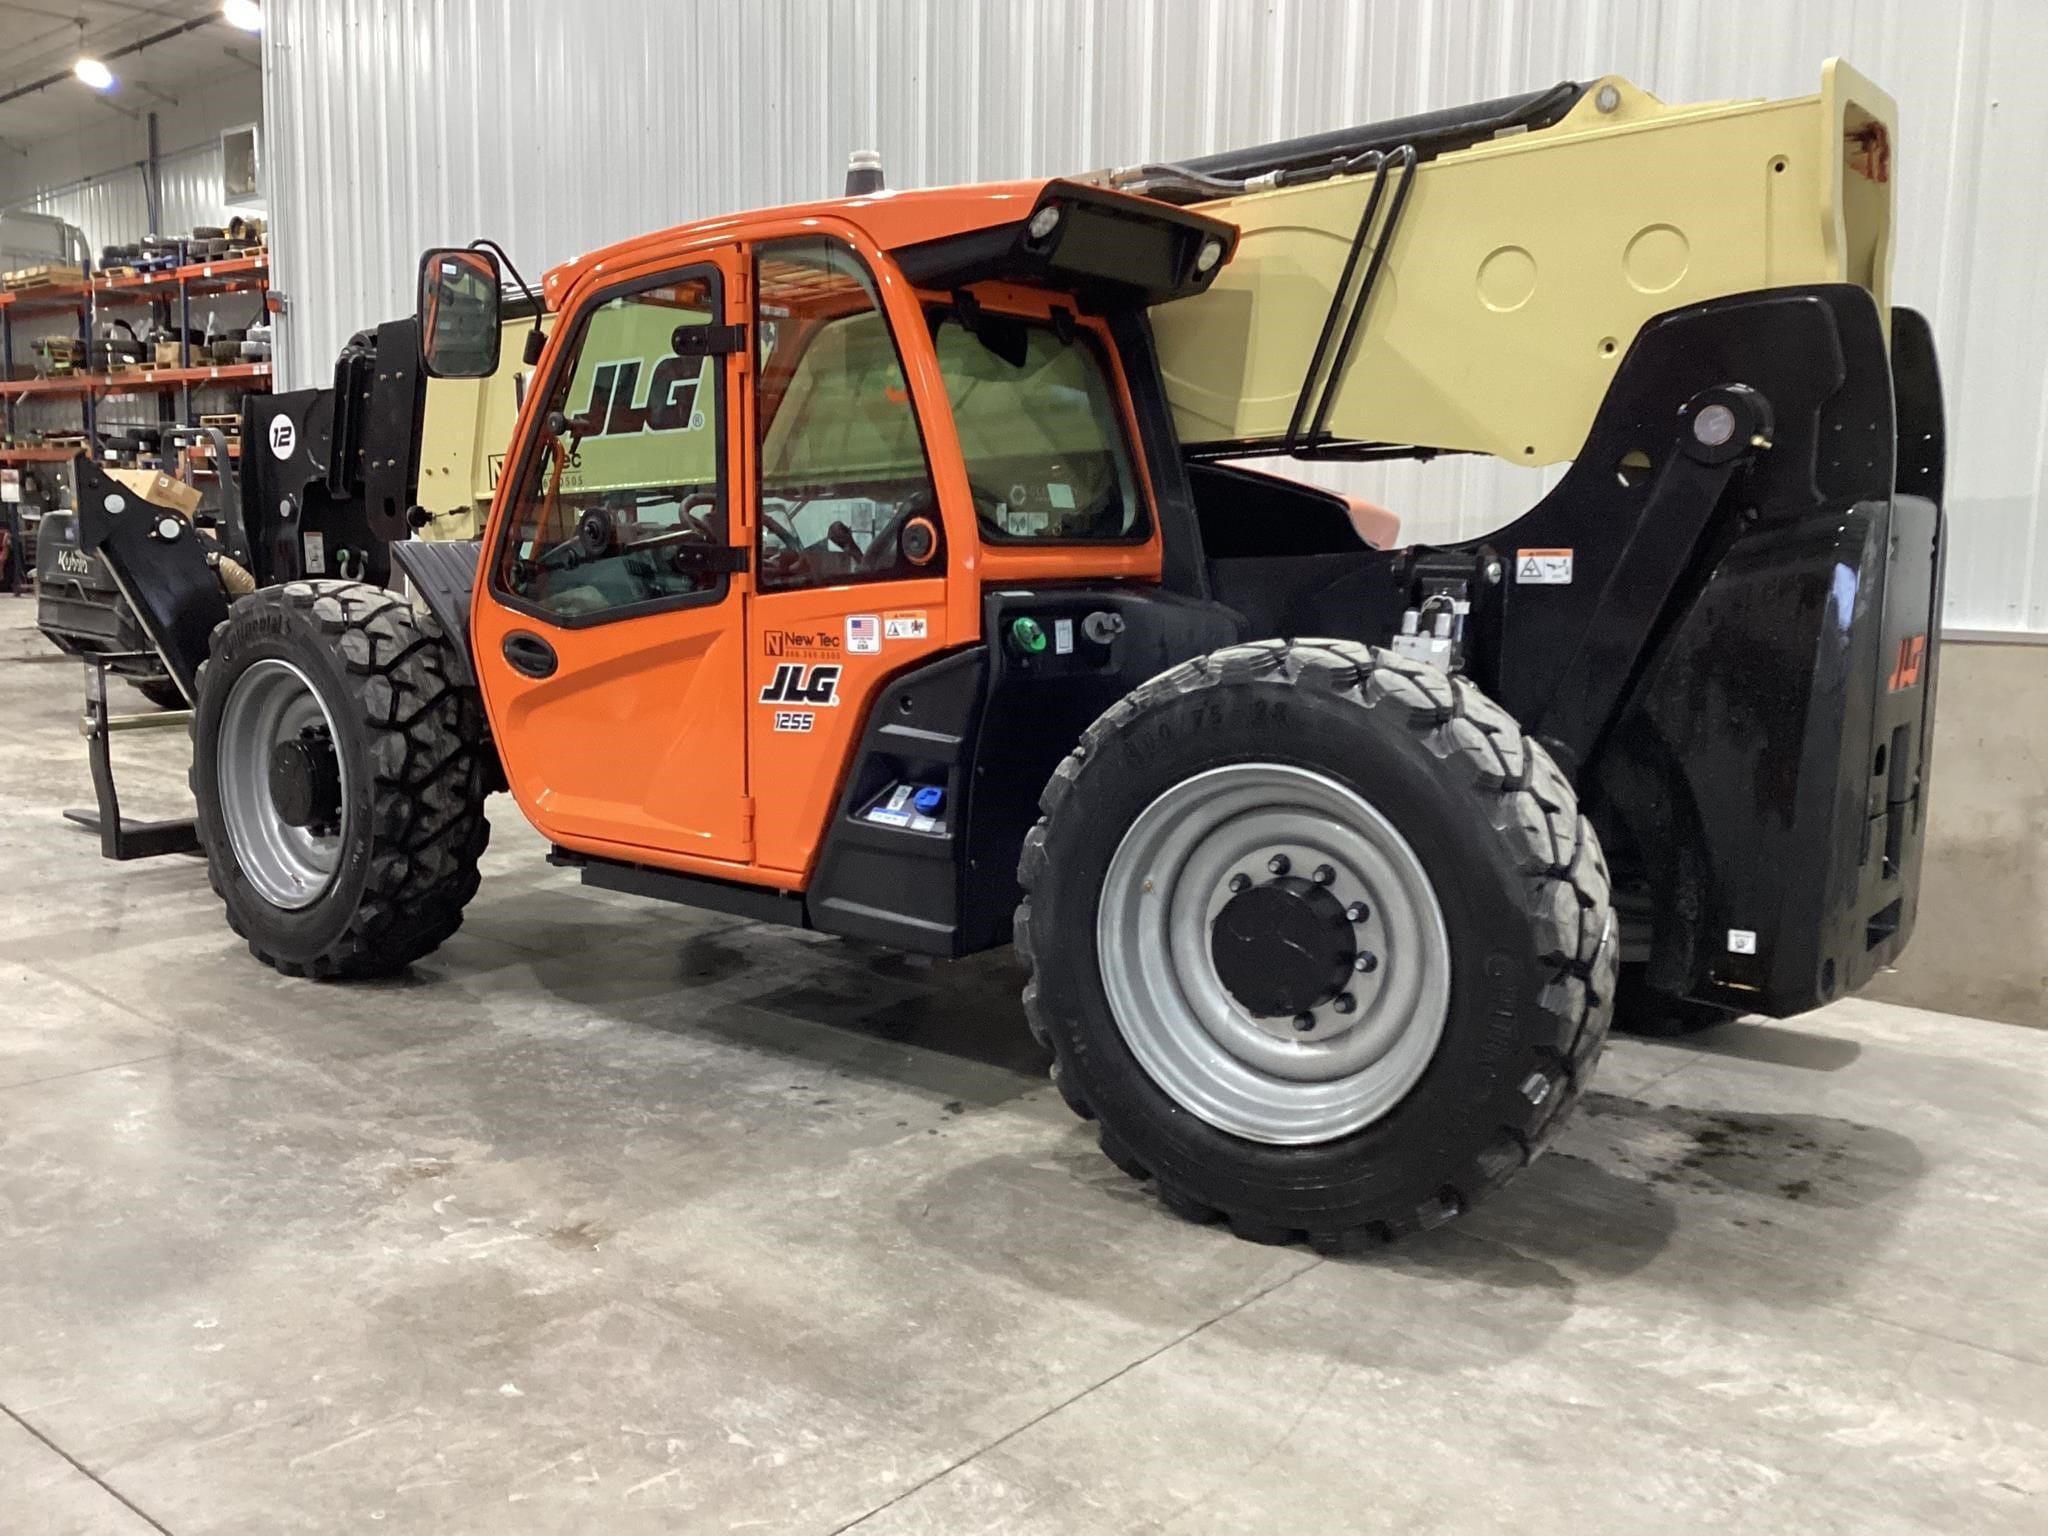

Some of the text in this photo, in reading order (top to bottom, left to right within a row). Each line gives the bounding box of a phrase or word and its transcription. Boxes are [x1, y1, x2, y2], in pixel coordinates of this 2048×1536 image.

[571, 356, 705, 438] JLG
[273, 425, 292, 449] 12
[785, 632, 814, 647] New
[817, 633, 840, 647] Tec
[1888, 634, 1925, 692] JLG
[761, 665, 839, 704] JLG
[776, 714, 813, 730] 1255
